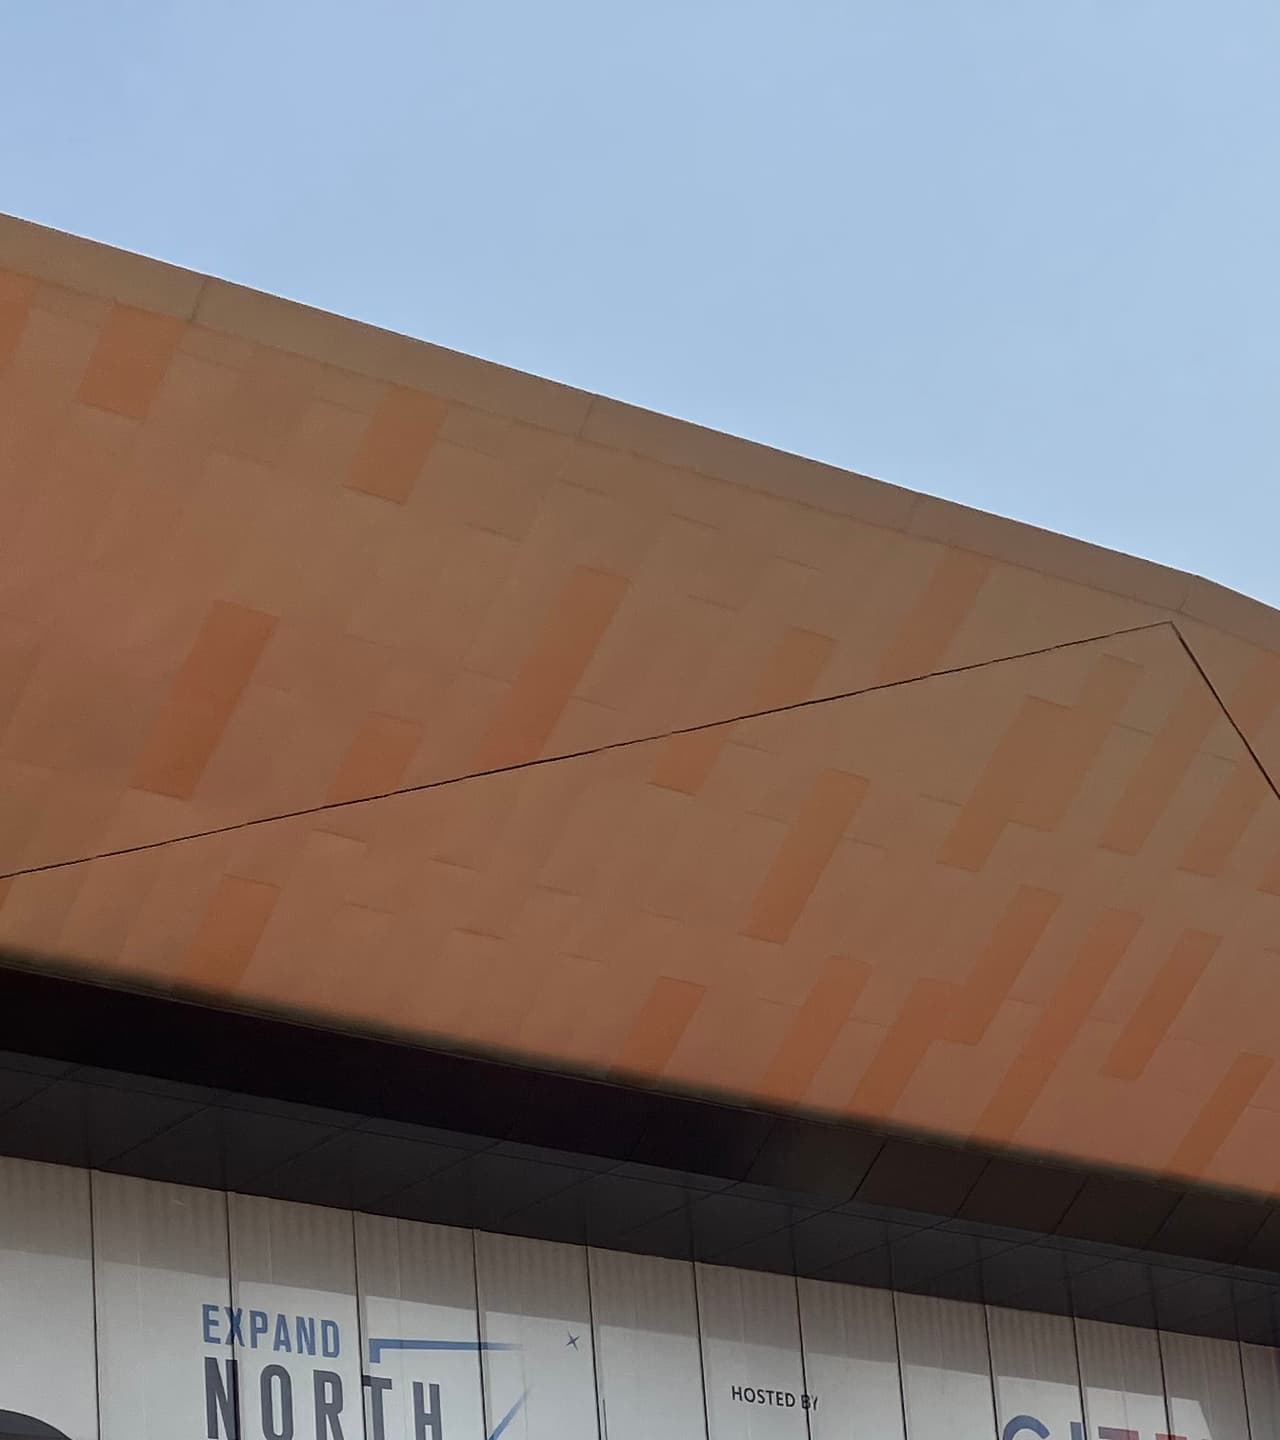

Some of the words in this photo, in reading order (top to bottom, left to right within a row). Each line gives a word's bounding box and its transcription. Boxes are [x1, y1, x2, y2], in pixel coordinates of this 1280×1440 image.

[202, 1303, 341, 1359] EXPAND
[731, 1385, 795, 1408] HOSTED
[800, 1394, 818, 1411] BY
